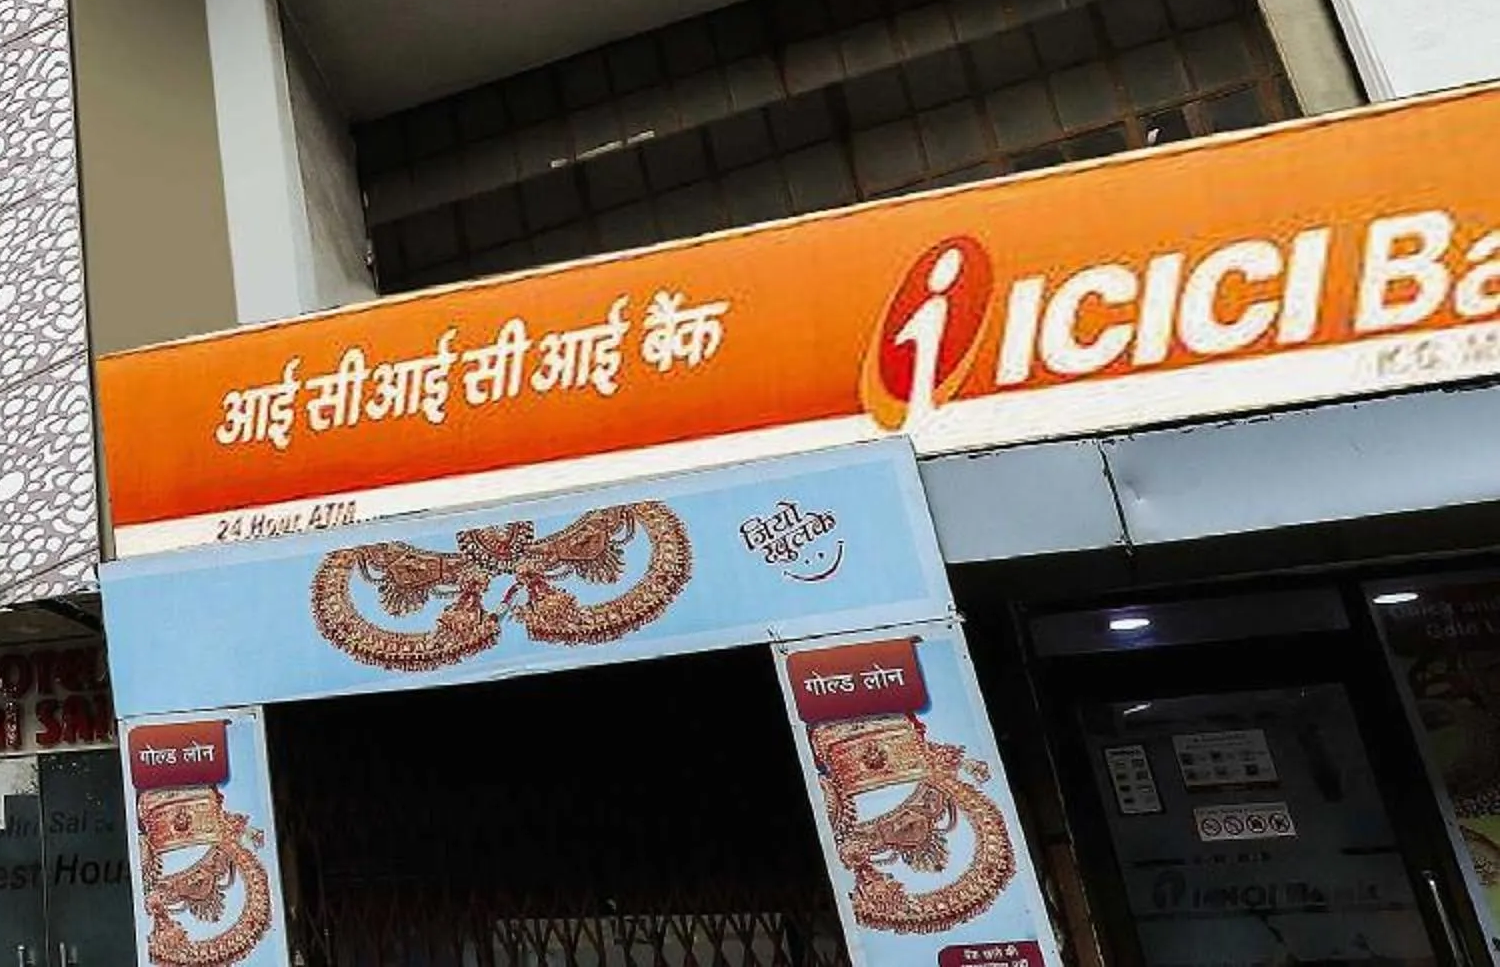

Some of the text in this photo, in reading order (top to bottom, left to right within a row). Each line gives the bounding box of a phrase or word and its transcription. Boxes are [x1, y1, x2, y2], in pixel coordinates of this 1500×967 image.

[996, 228, 1330, 386] ICICI
[216, 289, 730, 448] आई सी आई सी आई बैंक
[217, 516, 243, 540] 24
[804, 663, 905, 695] गोल्ड लोन
[139, 739, 215, 766] गोल्ड लोन
[55, 853, 130, 885] Hou
